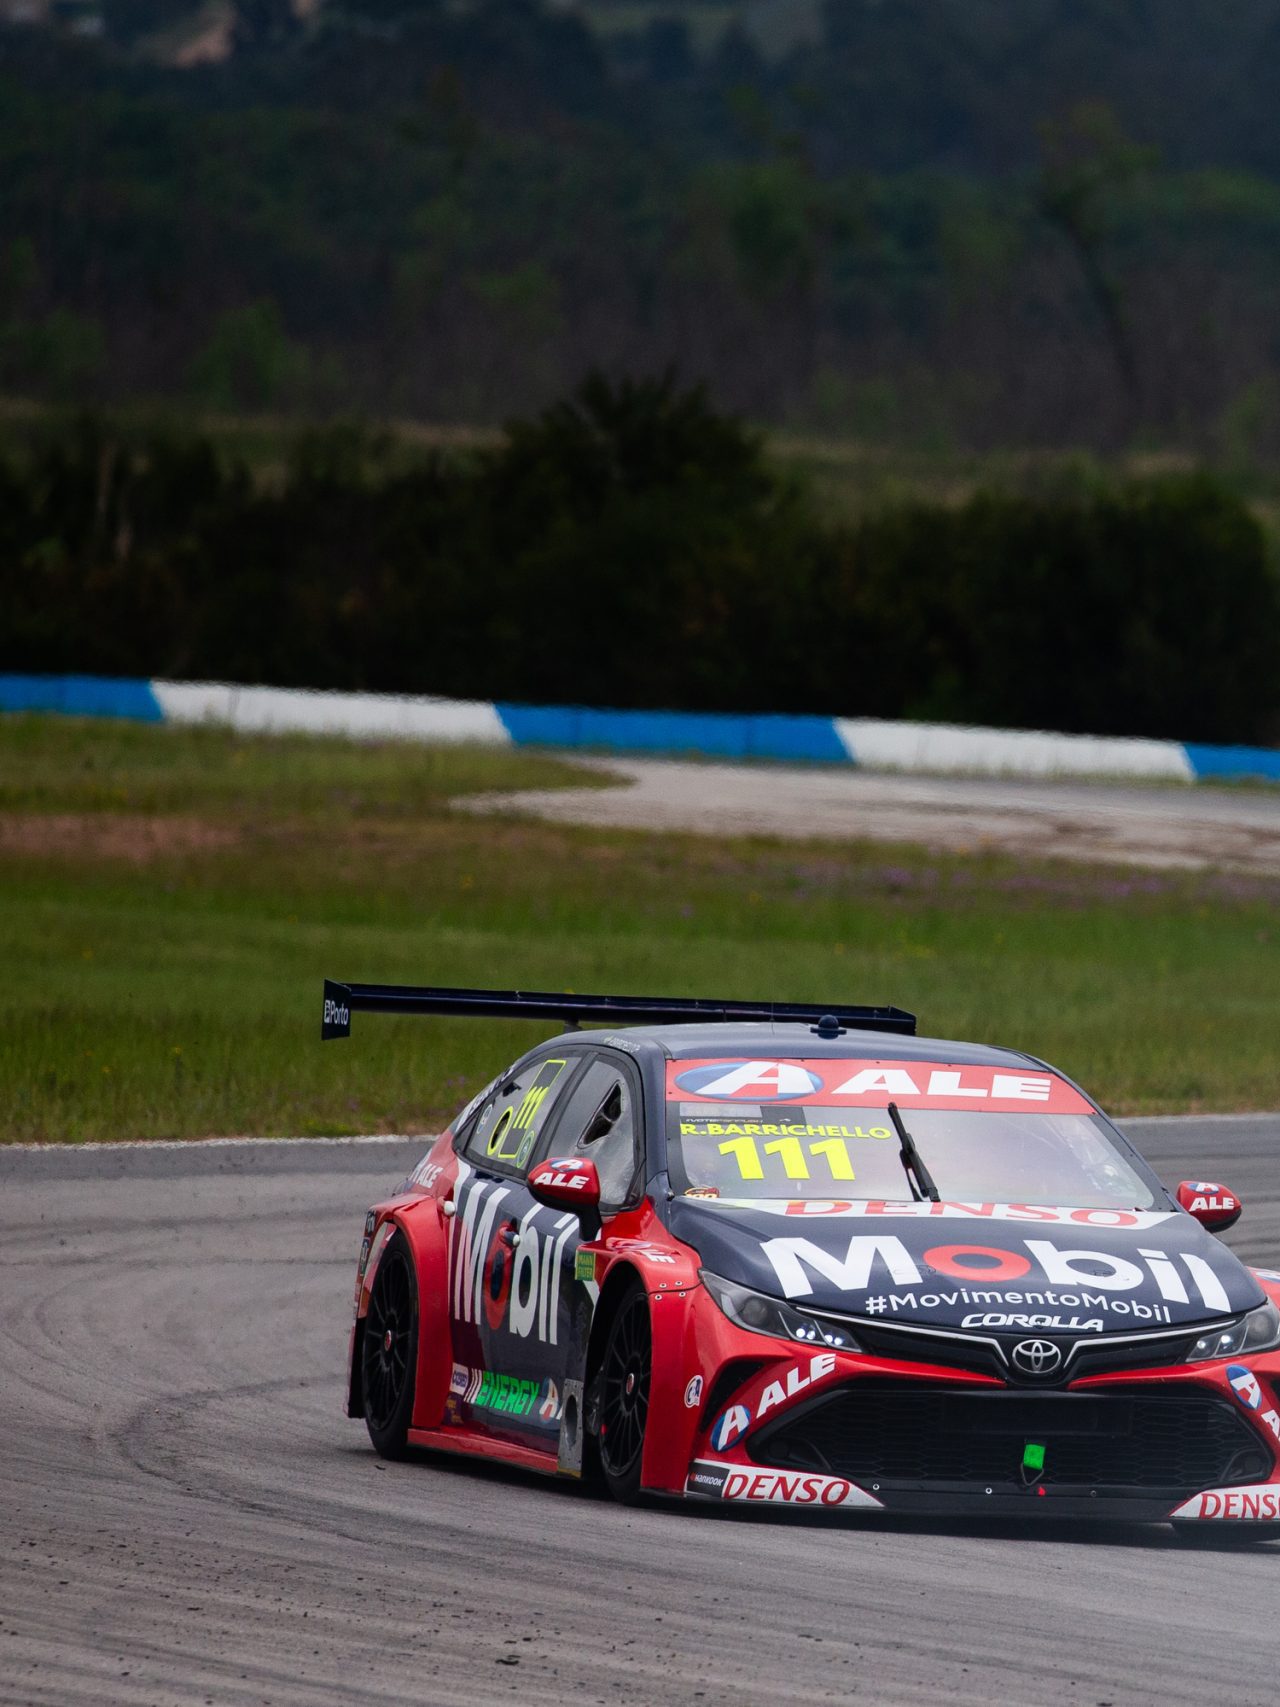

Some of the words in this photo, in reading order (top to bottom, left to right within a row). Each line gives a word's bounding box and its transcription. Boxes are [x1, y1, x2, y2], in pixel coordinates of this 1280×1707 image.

[330, 1000, 349, 1025] Porto
[831, 1069, 1051, 1100] ALE
[680, 1124, 892, 1139] R.BARRICHELLO
[718, 1136, 856, 1180] 111
[533, 1172, 590, 1190] ALE
[785, 1200, 1138, 1226] DENSO
[1189, 1197, 1234, 1212] ALE
[454, 1181, 580, 1346] Mobil
[760, 1235, 1231, 1313] Mobil
[865, 1288, 1171, 1323] #MovimentoMobil
[961, 1313, 1103, 1332] COROLLA
[476, 1370, 539, 1415] ENERGY
[756, 1354, 836, 1418] ALE
[724, 1474, 850, 1505] DENSO
